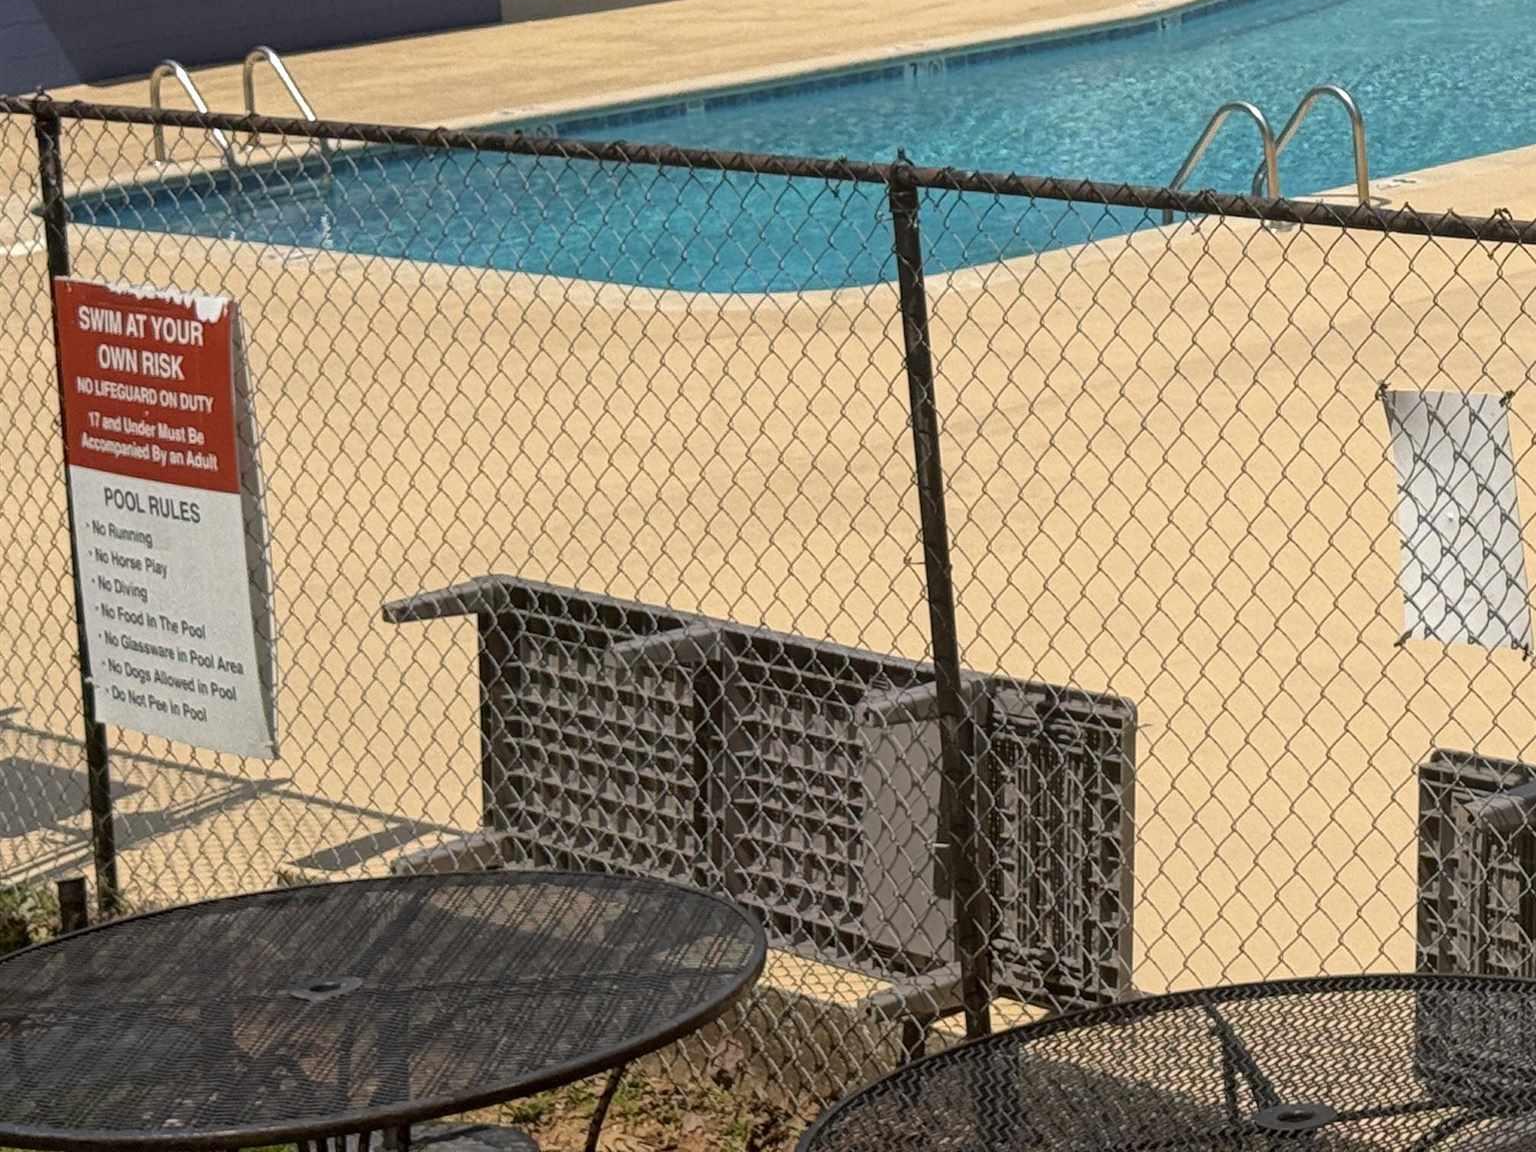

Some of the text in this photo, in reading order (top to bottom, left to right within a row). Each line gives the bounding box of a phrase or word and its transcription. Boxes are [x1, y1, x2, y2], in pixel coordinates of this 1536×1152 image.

[78, 305, 204, 346] SWIM AT YOUR
[98, 343, 185, 380] OWN RISK
[77, 376, 213, 414] NO LIFEGUARD ON DUTY
[88, 412, 204, 445] 17 and Under Must Be
[81, 432, 218, 471] Accompanied By an Adult
[104, 487, 201, 524] POOL RULES
[92, 520, 153, 549] No Running
[95, 547, 168, 579] No Horse Play
[98, 575, 148, 603] No Diving
[101, 603, 115, 619] No
[117, 606, 144, 626] Food
[159, 615, 179, 634] The
[181, 619, 206, 640] Pool
[103, 630, 118, 647] No
[120, 634, 175, 660] Glassware
[190, 649, 214, 668] Pool
[217, 656, 244, 675] Area
[107, 658, 122, 674] No
[124, 662, 151, 684] Dogs
[154, 669, 195, 692] Allowed
[210, 681, 237, 701] Pool
[112, 685, 126, 702] Do
[128, 689, 147, 708] Not
[147, 694, 168, 713] Pee
[182, 702, 208, 722] Pool
